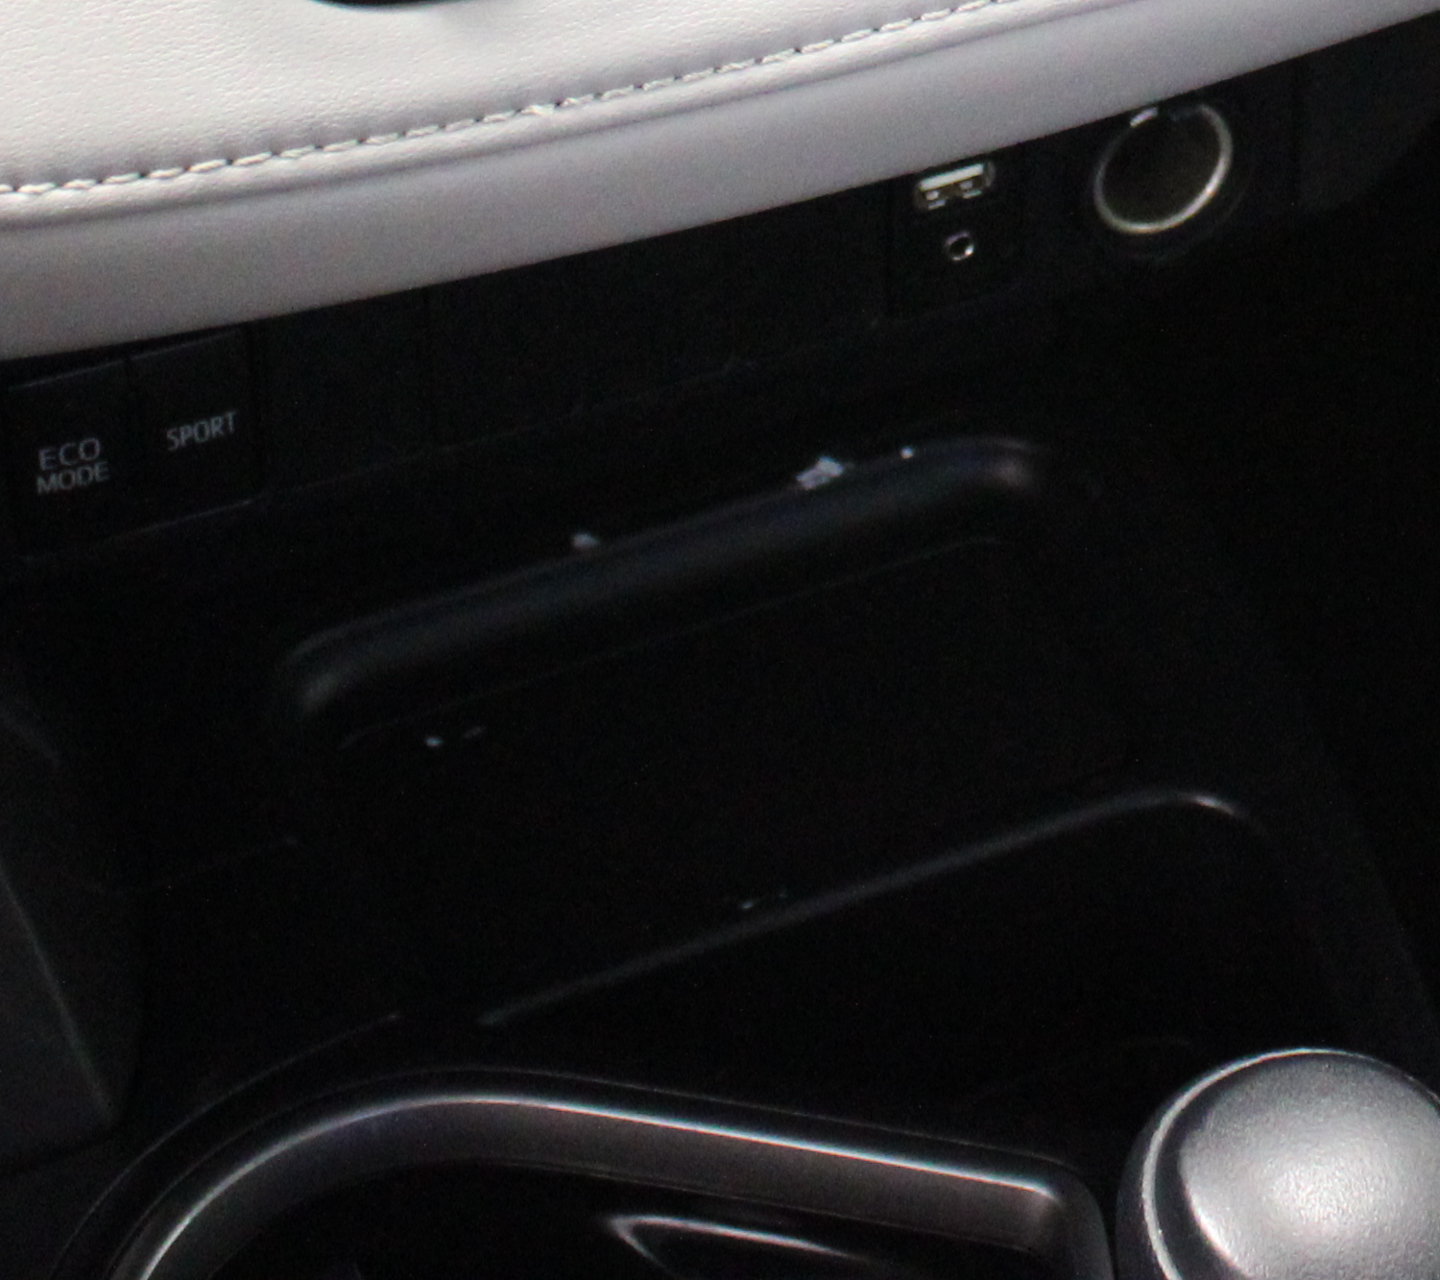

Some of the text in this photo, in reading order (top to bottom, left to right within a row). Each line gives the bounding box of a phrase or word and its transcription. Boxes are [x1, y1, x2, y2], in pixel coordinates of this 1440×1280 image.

[165, 411, 237, 451] SPORT
[38, 437, 102, 471] ECO
[36, 461, 111, 495] MODE
